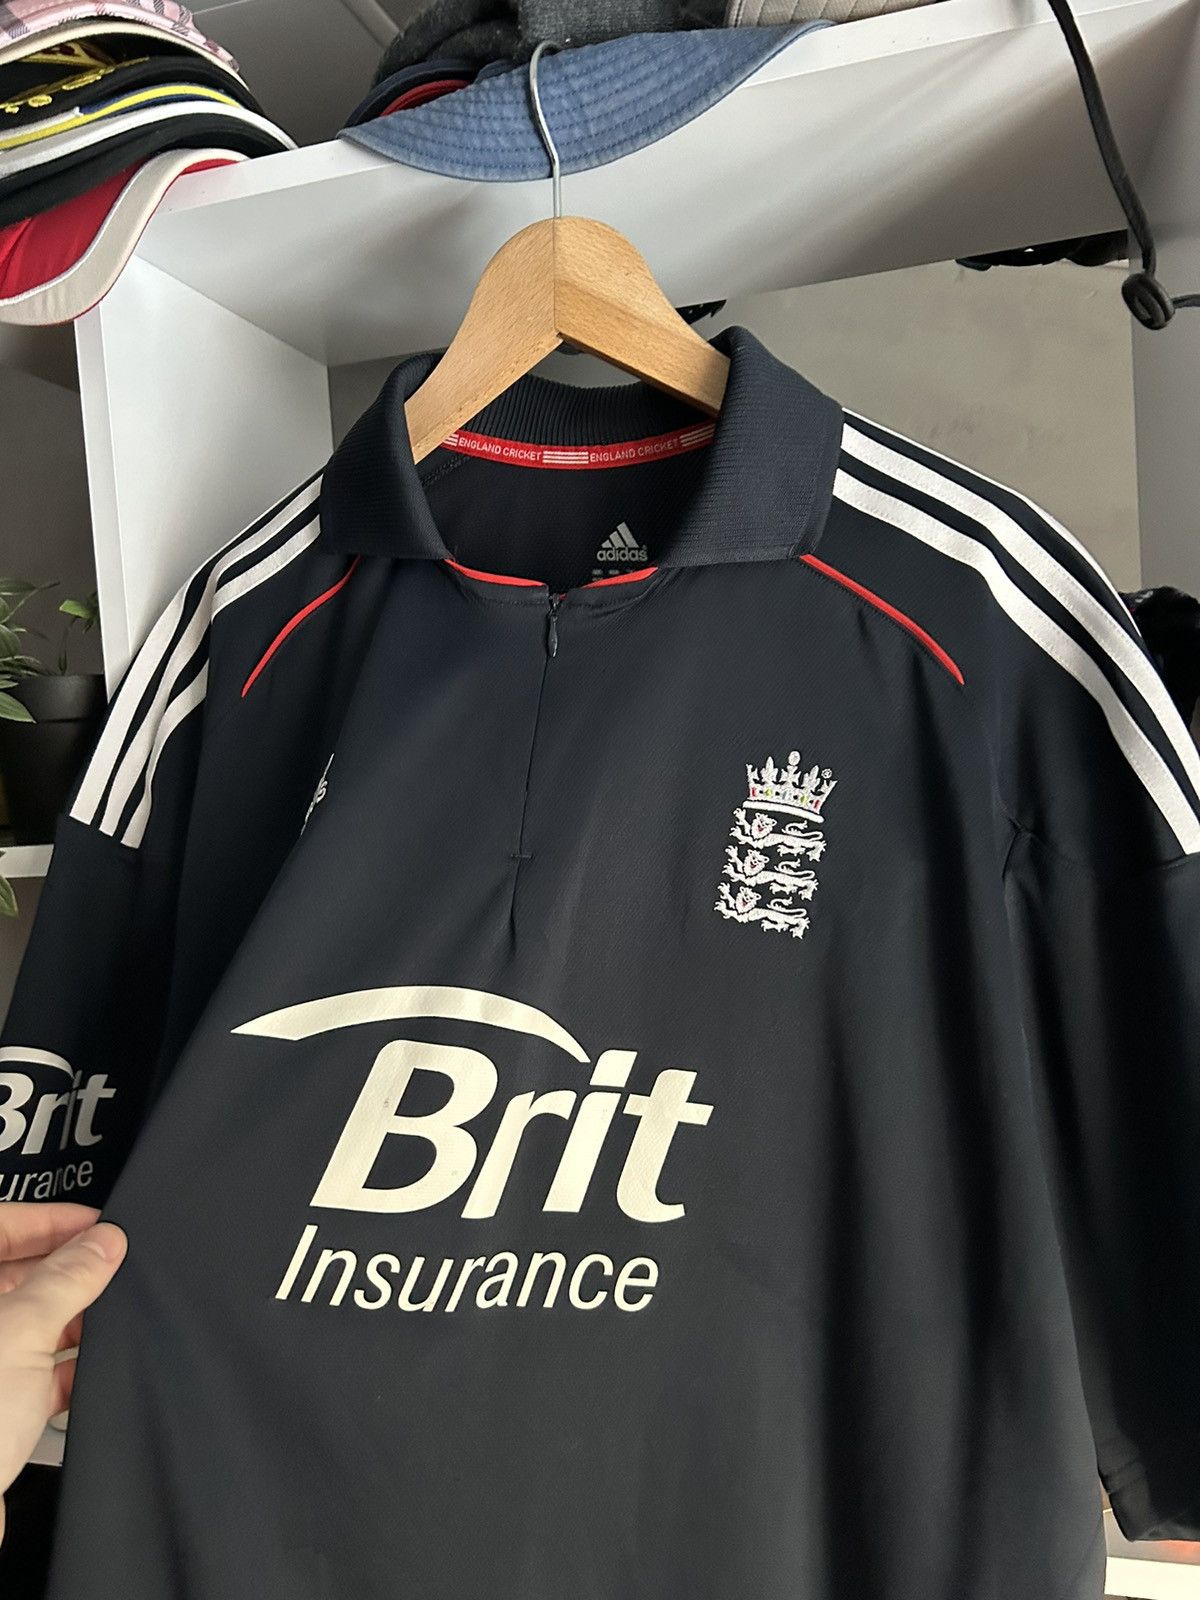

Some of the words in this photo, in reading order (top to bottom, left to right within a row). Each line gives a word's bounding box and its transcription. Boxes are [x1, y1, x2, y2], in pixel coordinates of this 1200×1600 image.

[458, 437, 501, 455] ENGLAND
[502, 447, 542, 461] CRICKET
[589, 448, 636, 463] ENGLAND
[637, 438, 679, 456] CRICKET
[596, 547, 648, 561] adidas
[309, 1039, 714, 1223] Brit
[275, 1224, 659, 1312] Insurance
